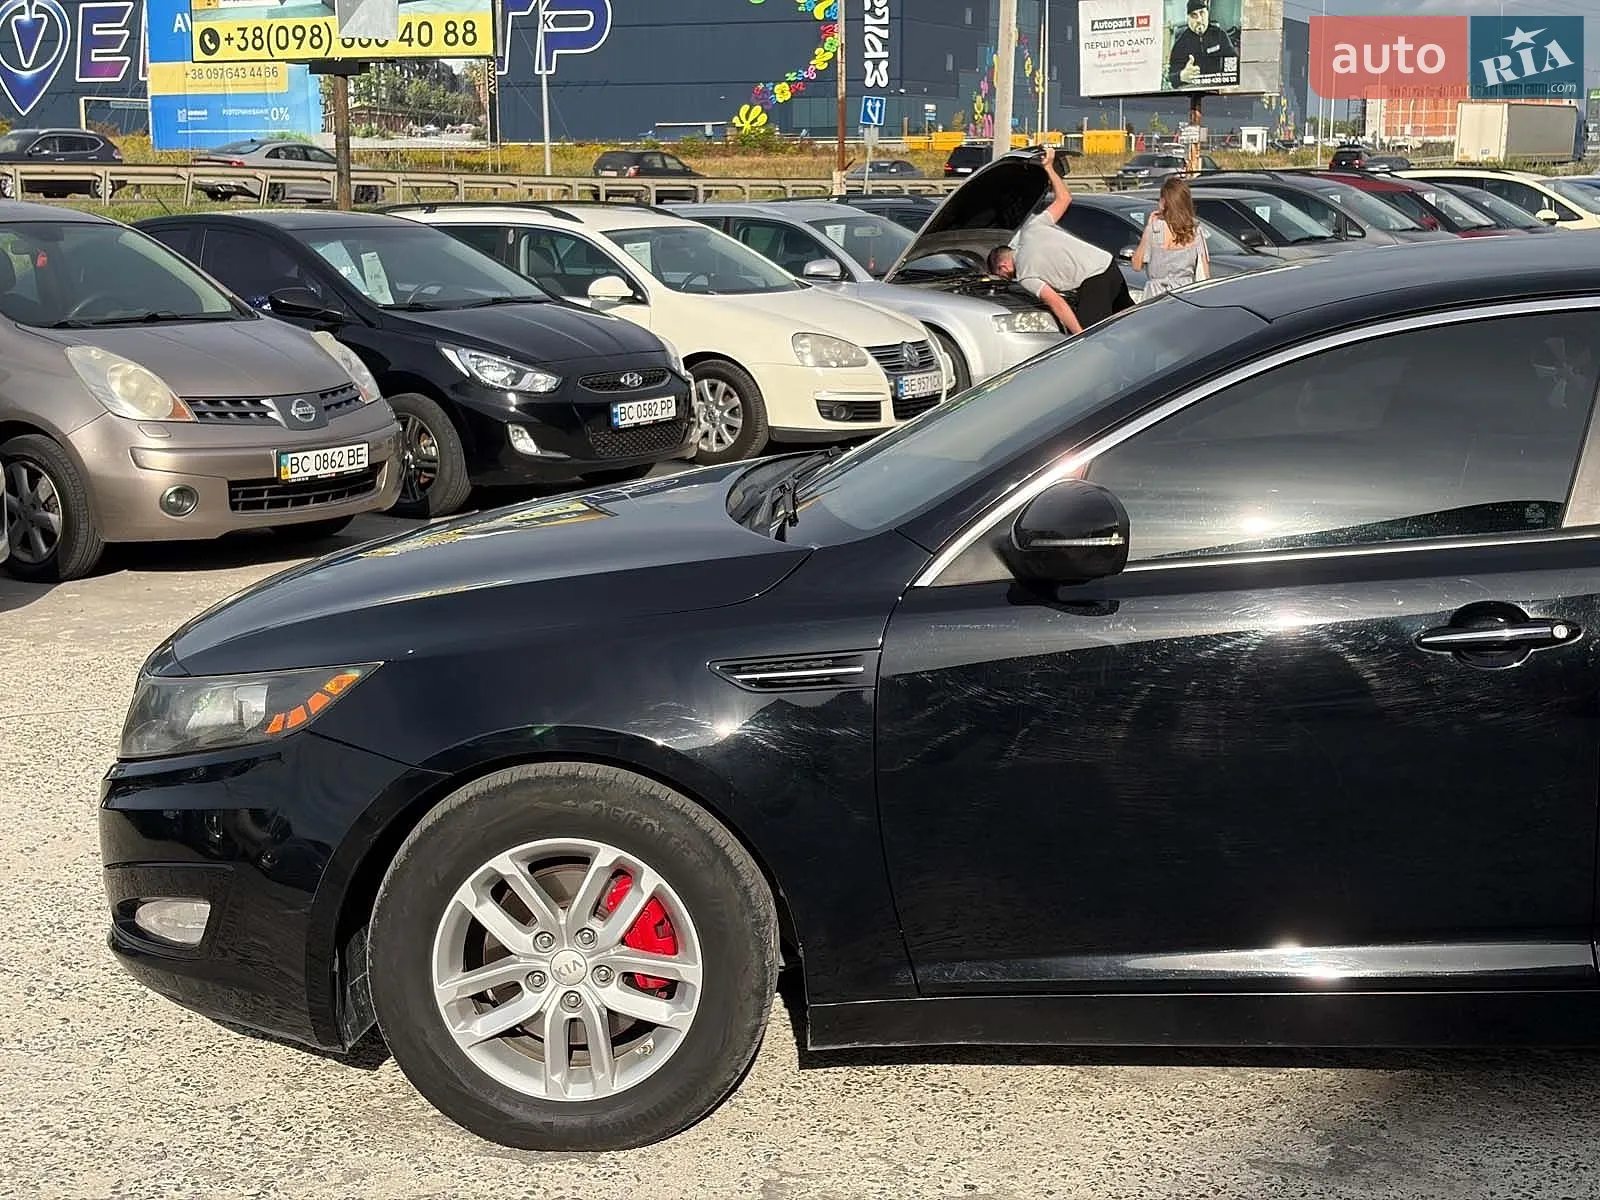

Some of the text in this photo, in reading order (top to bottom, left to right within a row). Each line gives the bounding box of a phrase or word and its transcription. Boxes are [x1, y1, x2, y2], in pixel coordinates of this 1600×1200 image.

[1092, 17, 1133, 30] Autopark
[224, 22, 332, 58] +38(098)
[398, 21, 433, 48] 40
[443, 20, 478, 47] 88
[1084, 40, 1111, 50] ПЕРШІ
[1113, 39, 1125, 48] ПО
[249, 67, 262, 79] 44
[264, 66, 279, 78] 66
[270, 107, 290, 121] 0%
[620, 400, 673, 421] BC 0582 PP
[290, 447, 365, 475] BC 0862 BE
